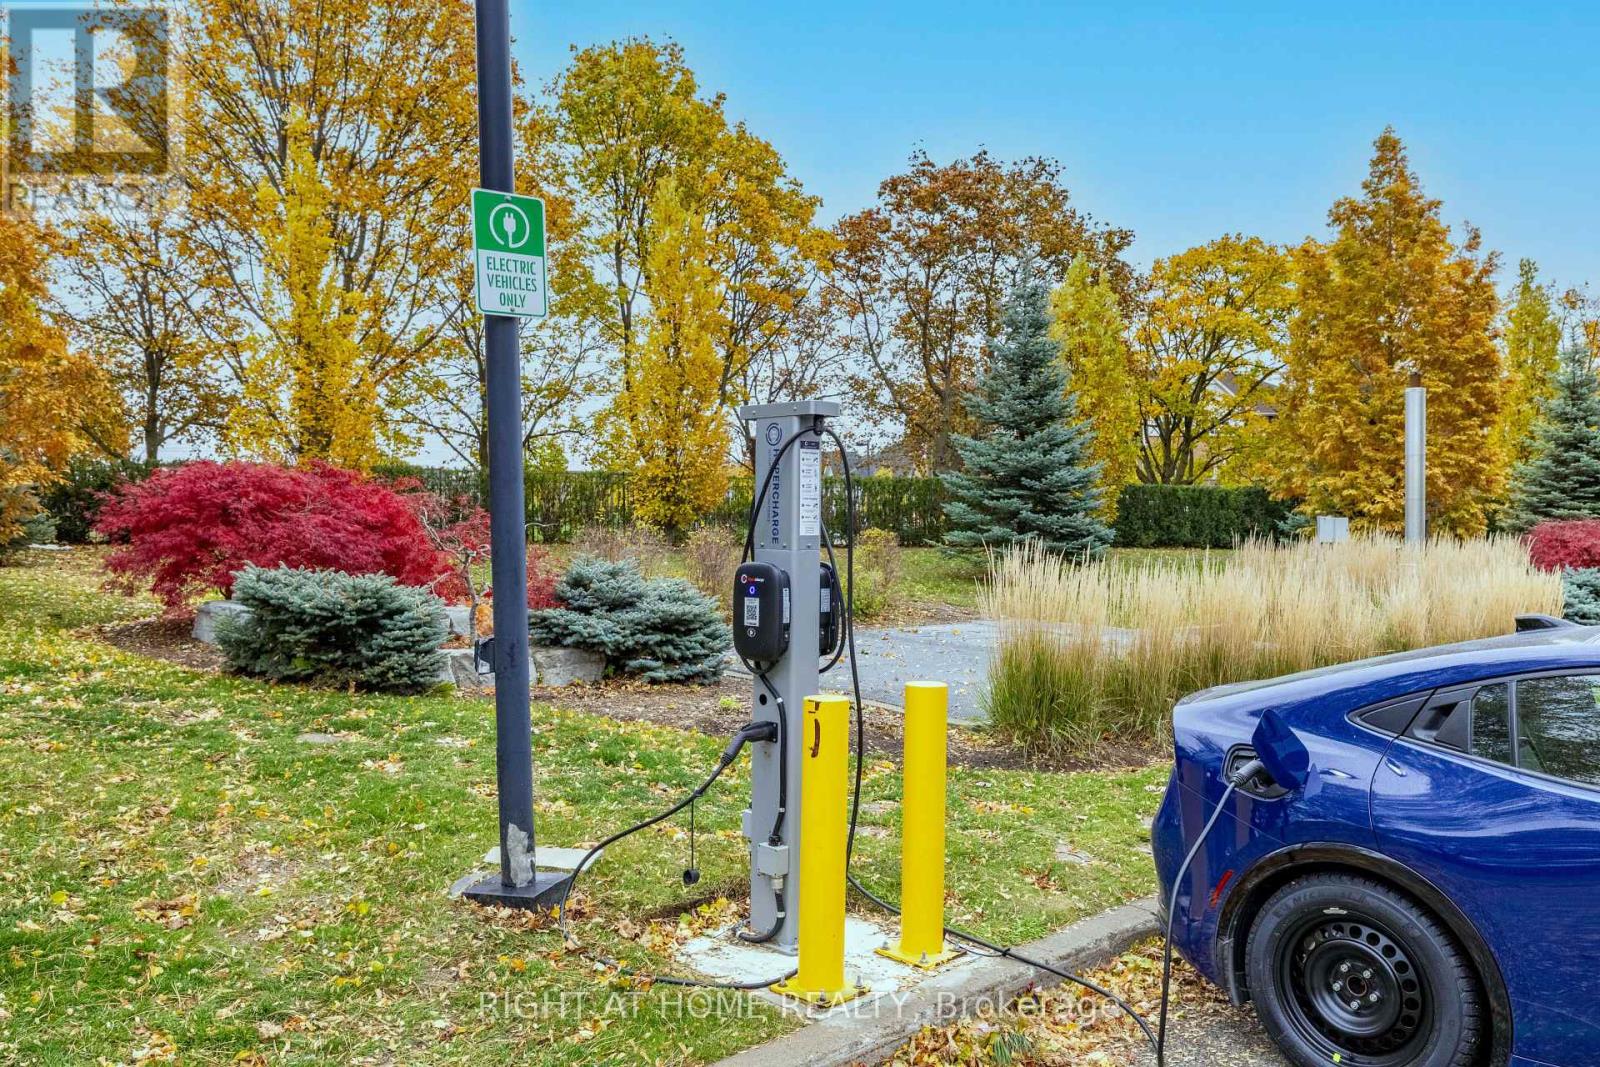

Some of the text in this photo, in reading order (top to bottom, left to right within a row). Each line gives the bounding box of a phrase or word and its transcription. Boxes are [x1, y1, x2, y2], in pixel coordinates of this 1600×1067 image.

[486, 256, 536, 275] ELECTRIC
[487, 273, 537, 292] VEHICLES
[499, 292, 526, 308] ONLY
[772, 449, 780, 544] HPERCHARGE
